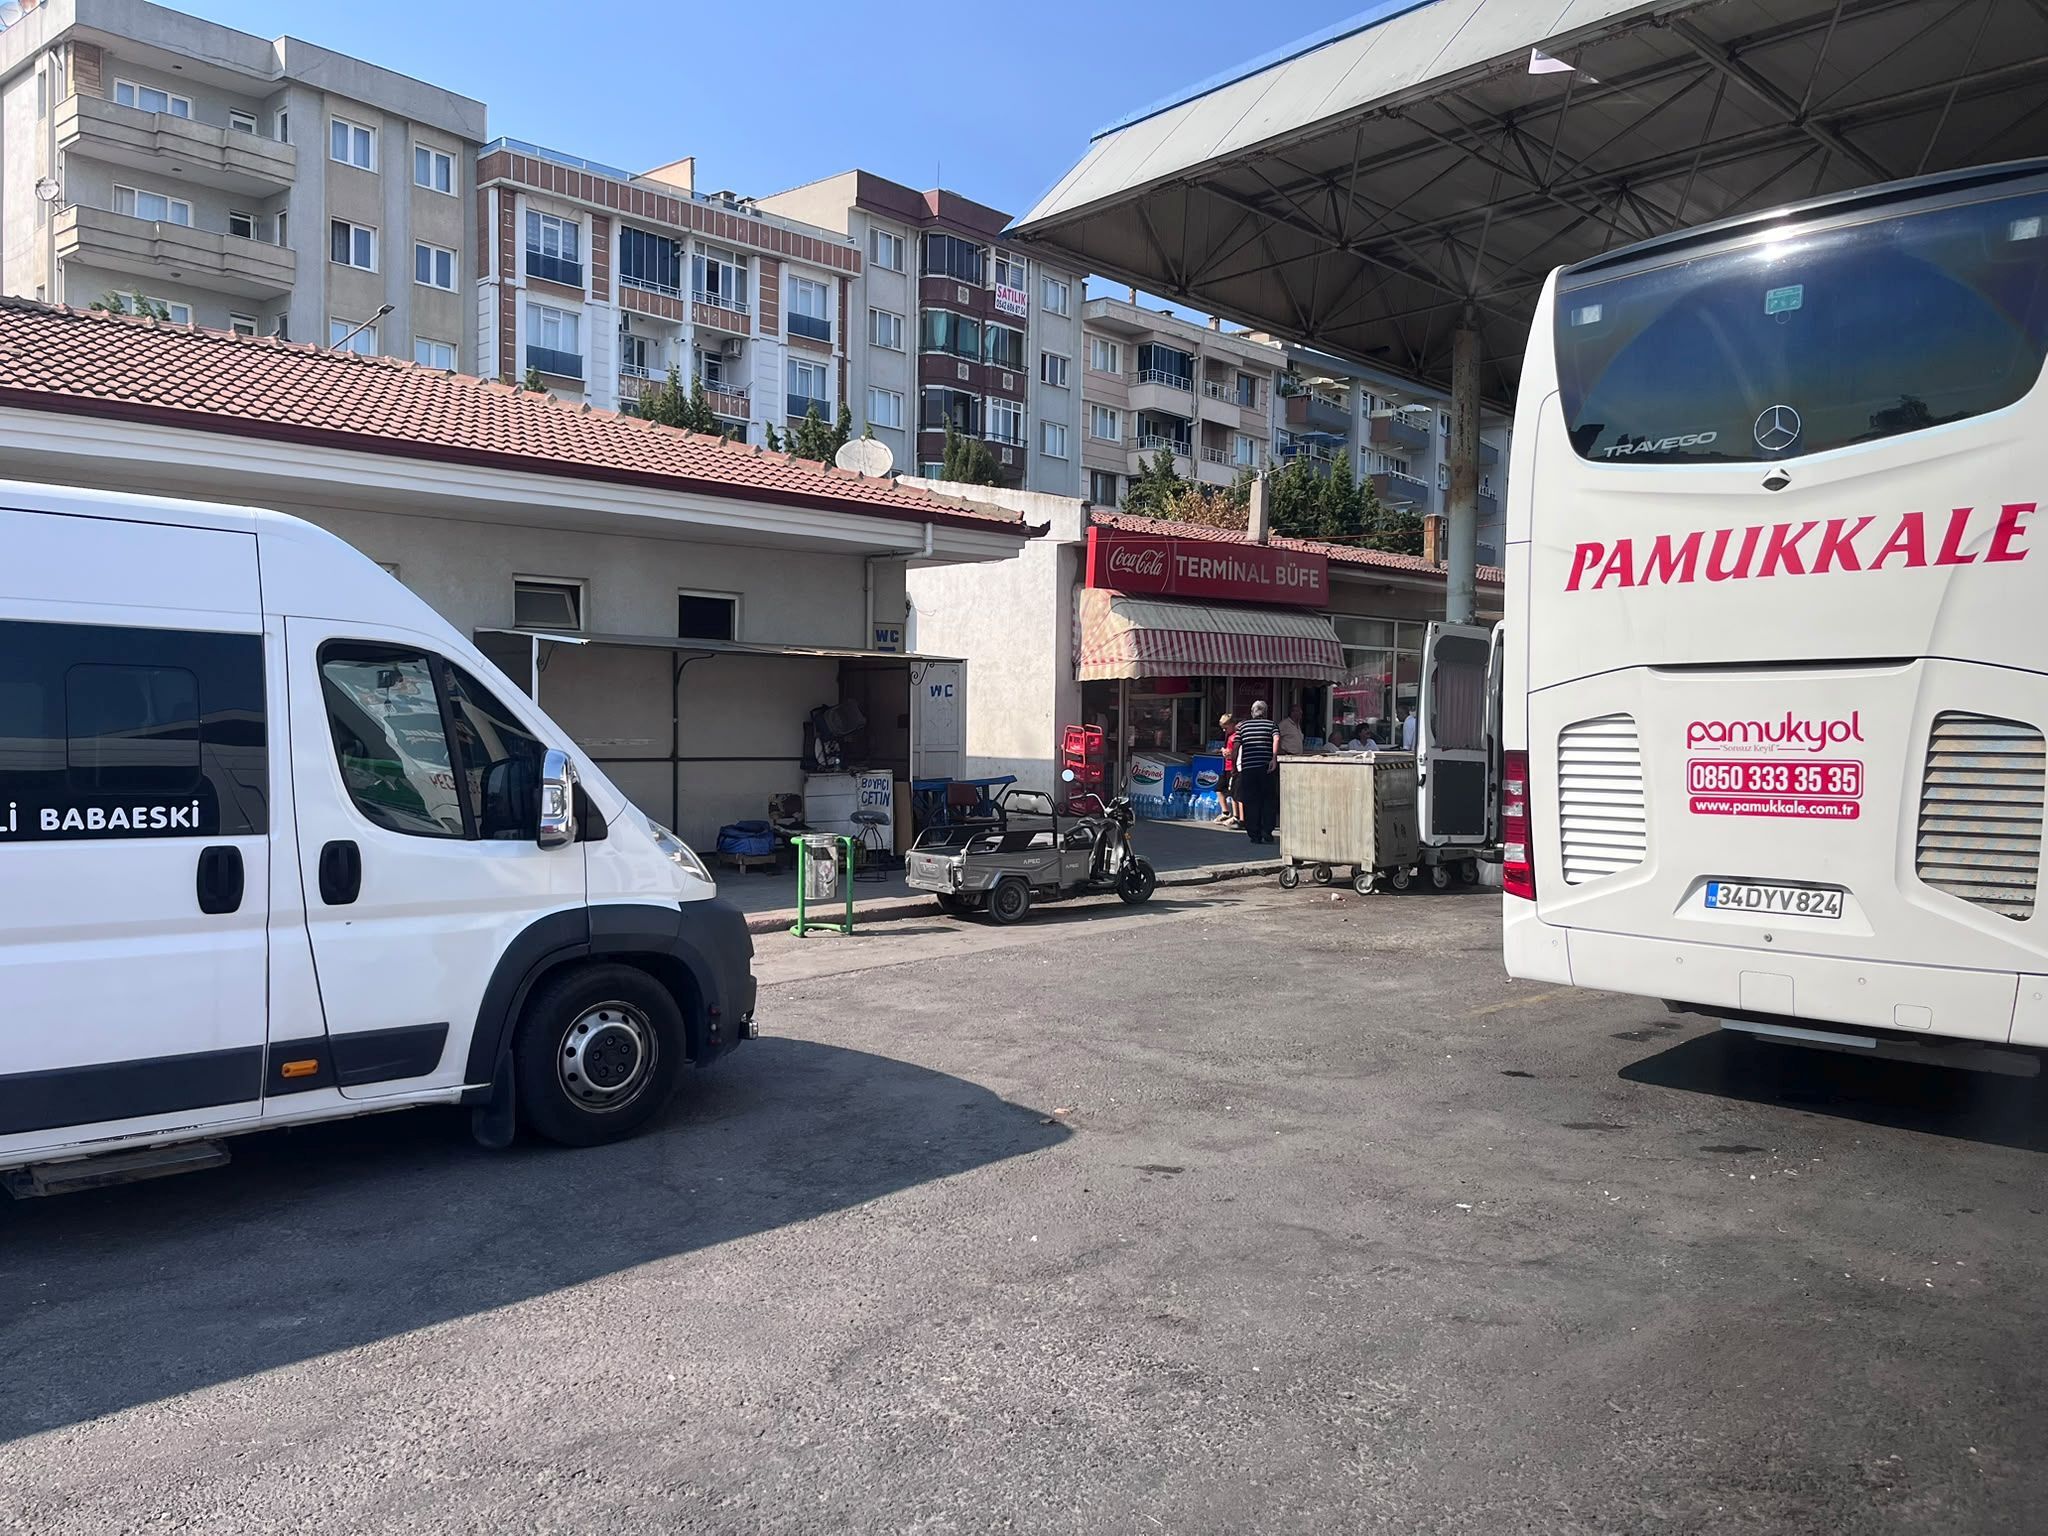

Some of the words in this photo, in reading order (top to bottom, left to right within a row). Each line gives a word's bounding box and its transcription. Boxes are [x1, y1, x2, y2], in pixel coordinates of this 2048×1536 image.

[997, 286, 1026, 305] SATILIK
[1604, 432, 1717, 457] TRAVEGO
[1110, 546, 1166, 576] Coca-Cola
[1564, 503, 2037, 592] PAMUKKALE
[1176, 555, 1270, 584] TERMİNAL
[1276, 563, 1319, 588] BÜFE
[875, 629, 899, 642] WC
[930, 684, 953, 697] WC
[1687, 711, 1864, 752] pamukyol
[861, 777, 889, 791] BOYACI
[1693, 765, 1743, 790] 0850
[1748, 766, 1788, 791] 333
[1794, 767, 1821, 792] 35
[1828, 768, 1856, 793] 35
[40, 800, 199, 831] BABAESKİ
[1696, 800, 1853, 816] www.pamukkale.com.tr
[1718, 885, 1838, 914] 34DYV824
